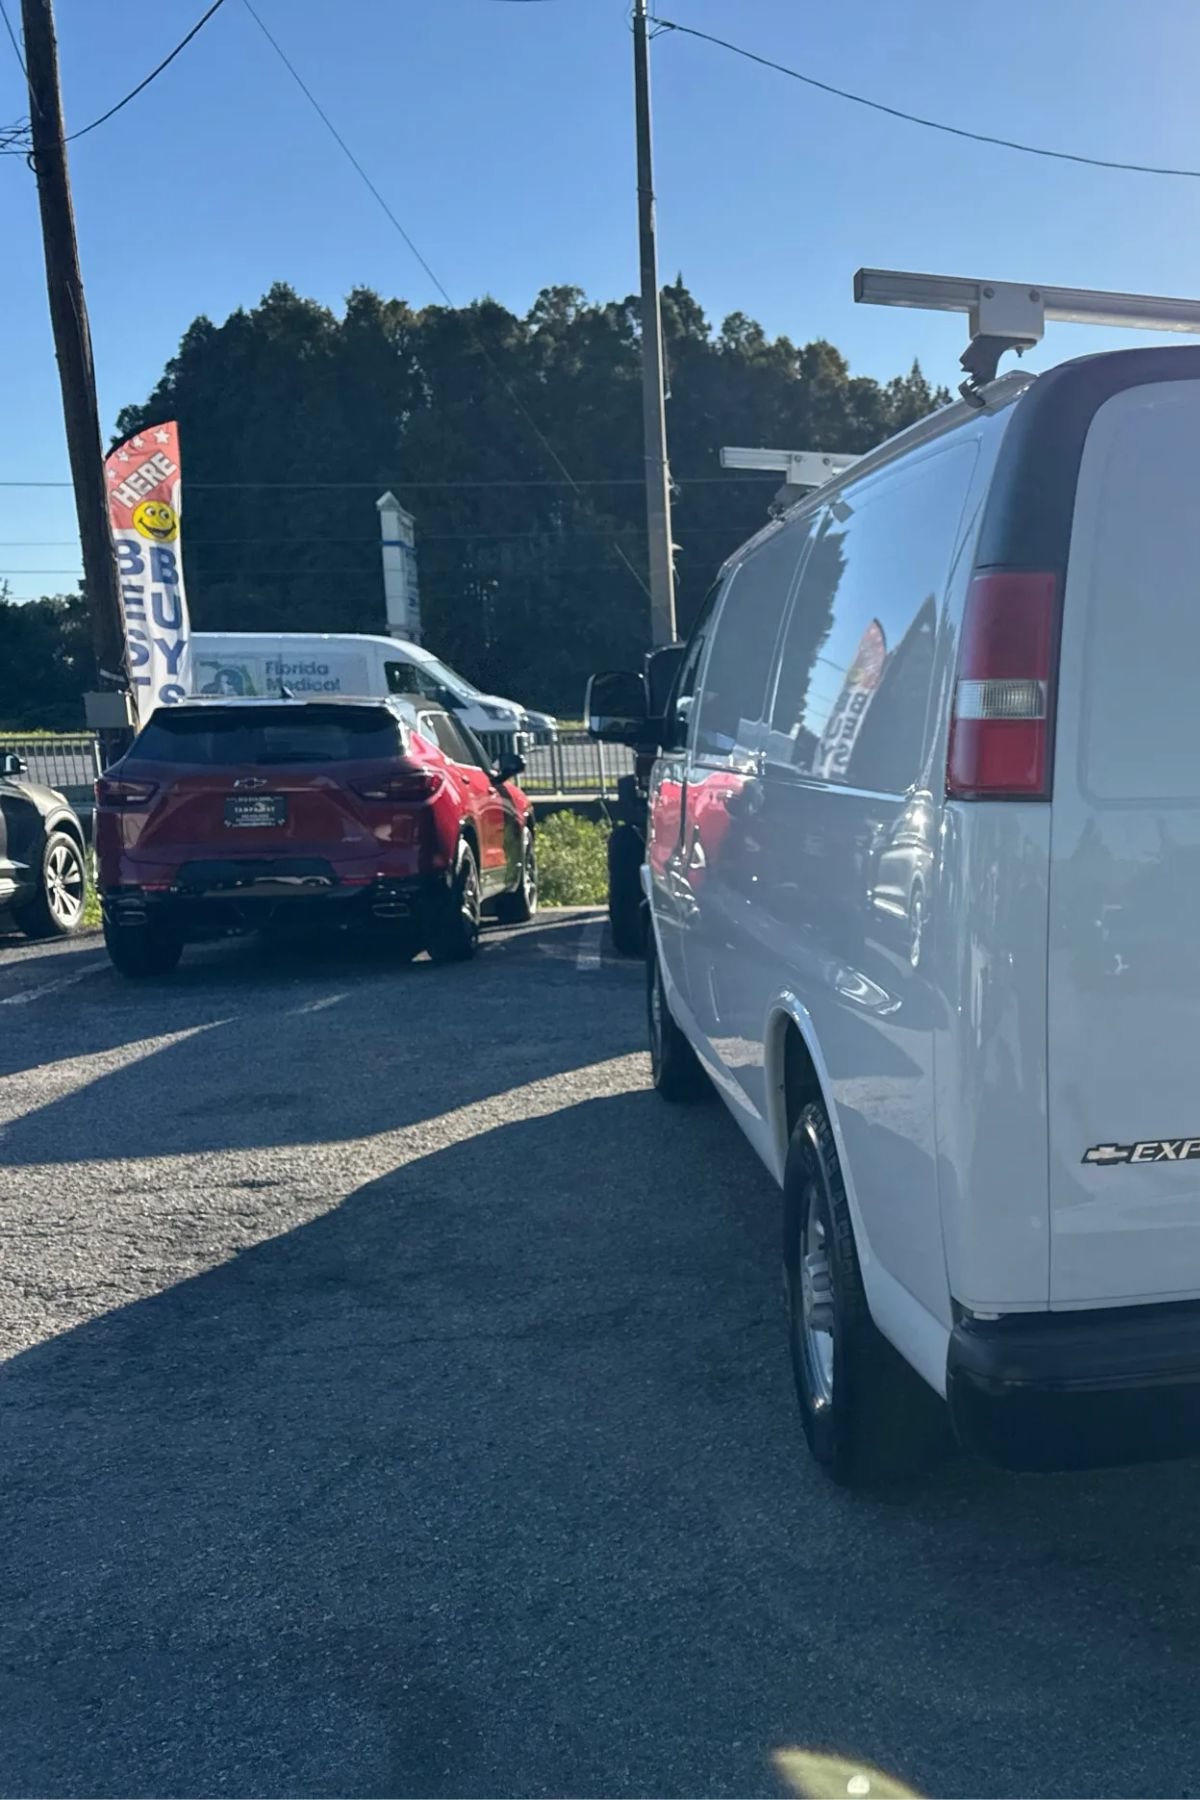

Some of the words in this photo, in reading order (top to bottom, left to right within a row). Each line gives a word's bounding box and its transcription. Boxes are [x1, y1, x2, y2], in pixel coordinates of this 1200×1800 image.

[111, 451, 178, 509] HERE
[265, 660, 330, 676] Florida
[266, 677, 341, 692] Medical
